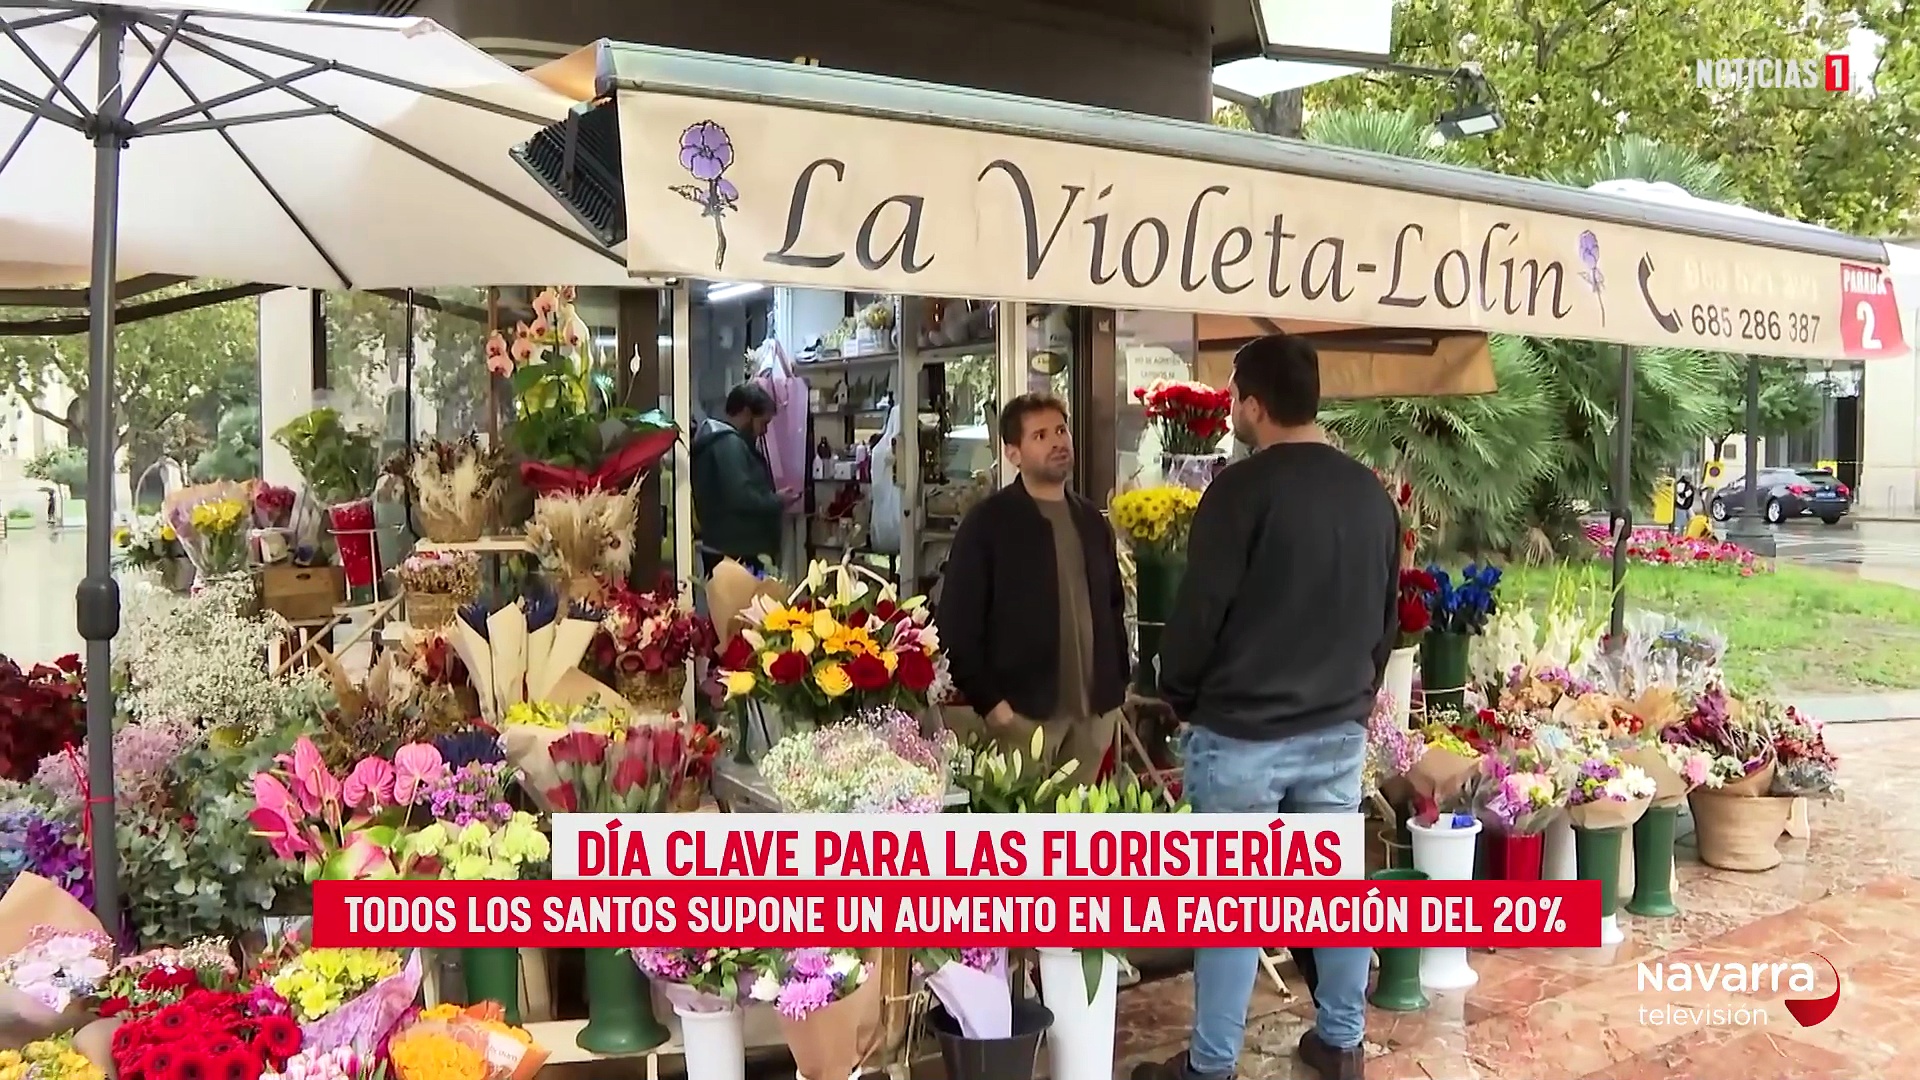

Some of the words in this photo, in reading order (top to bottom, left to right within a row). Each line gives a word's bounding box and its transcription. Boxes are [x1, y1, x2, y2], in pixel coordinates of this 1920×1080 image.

[763, 158, 936, 275] La
[1843, 268, 1887, 295] PARADA
[1691, 303, 1732, 338] 685
[1739, 308, 1781, 341] 286
[1788, 312, 1820, 344] 387
[1856, 300, 1883, 349] 2
